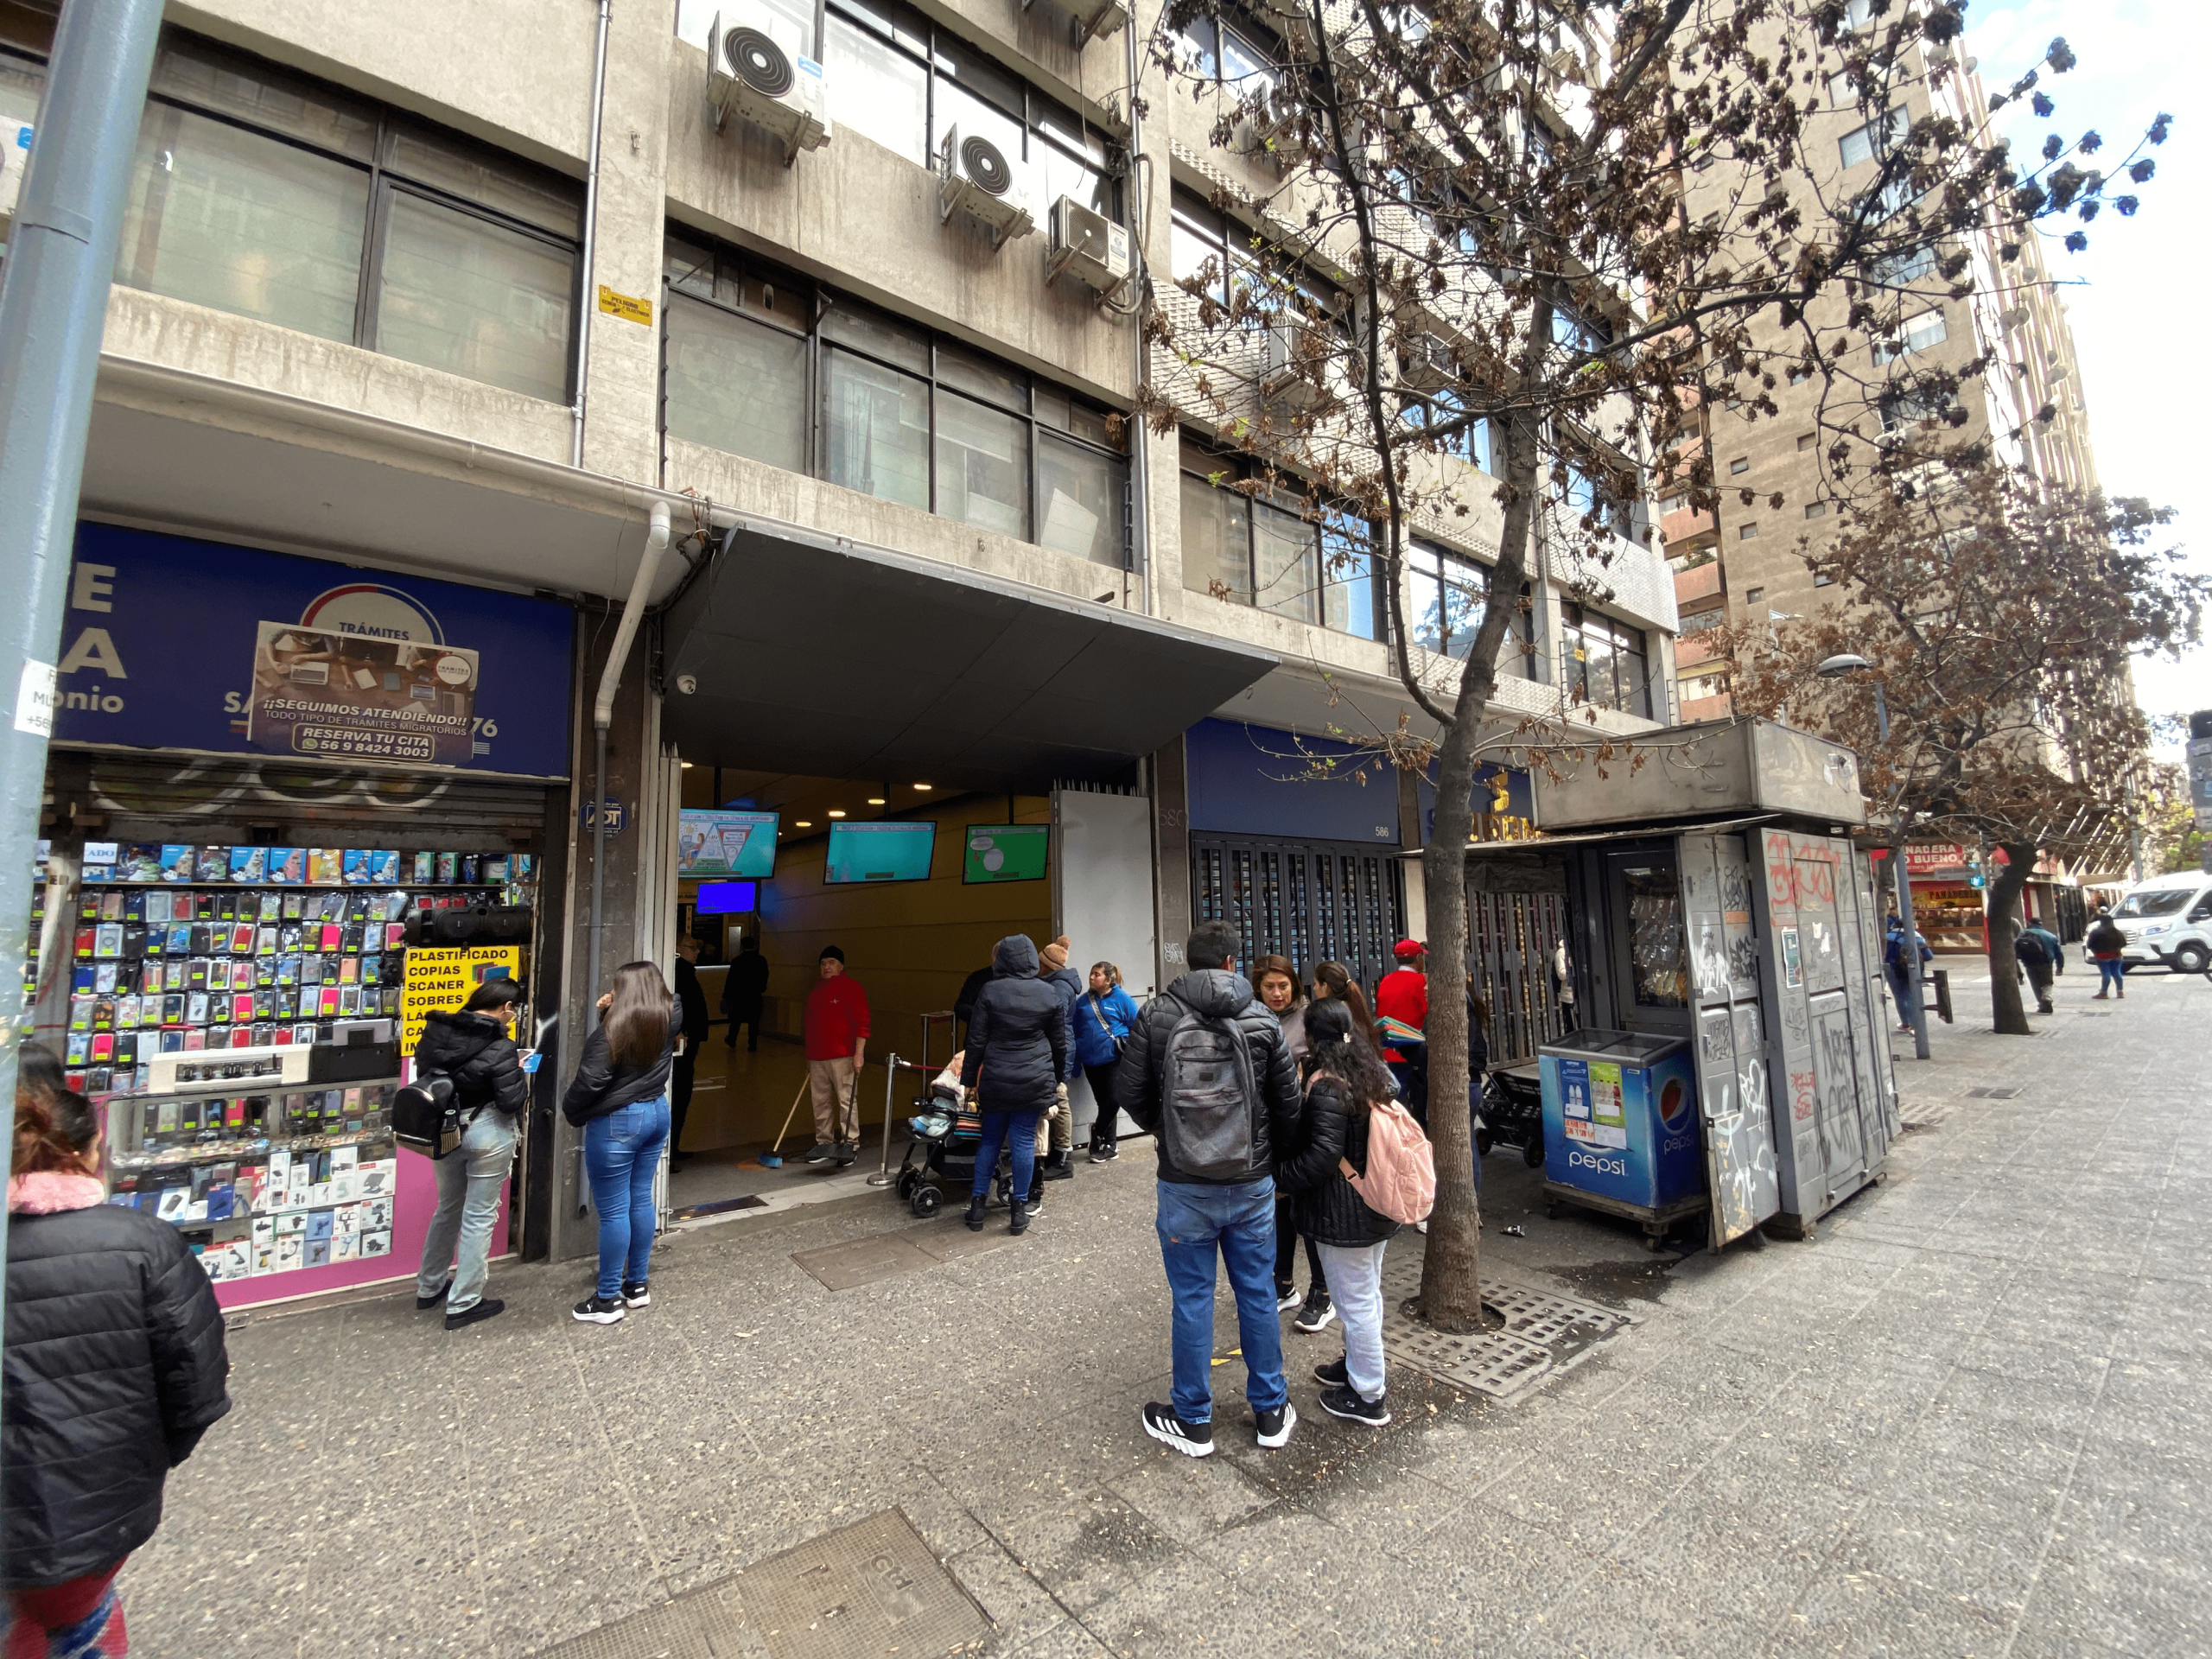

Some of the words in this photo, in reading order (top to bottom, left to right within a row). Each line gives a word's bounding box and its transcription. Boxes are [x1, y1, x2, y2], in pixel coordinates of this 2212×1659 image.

[612, 296, 639, 309] PELIGRO
[340, 621, 410, 640] TRÁMITES
[57, 627, 128, 679] A
[265, 709, 296, 721] TODO
[300, 713, 325, 723] TIPO
[328, 715, 343, 725] DE
[346, 715, 397, 730] TRÁMITES
[399, 721, 467, 736] MIGRATORIOS
[363, 706, 467, 728] ATENDIENDO!!
[302, 727, 372, 741] RESERVA
[376, 733, 394, 745] TU
[397, 735, 429, 748] CITA
[320, 740, 341, 751] 56
[342, 741, 353, 752] 9
[355, 742, 391, 756] 8424
[393, 746, 429, 759] 3003
[1375, 826, 1389, 837] 586
[1904, 844, 1956, 855] NADERA
[1914, 854, 1958, 864] BUENO
[410, 950, 508, 962] PLASTIFICADO
[409, 965, 461, 976] COPIAS
[408, 980, 465, 991] SCANER
[407, 995, 464, 1007] SOBRES
[1663, 1131, 1694, 1155] pepsi
[1568, 1151, 1625, 1177] pepsi
